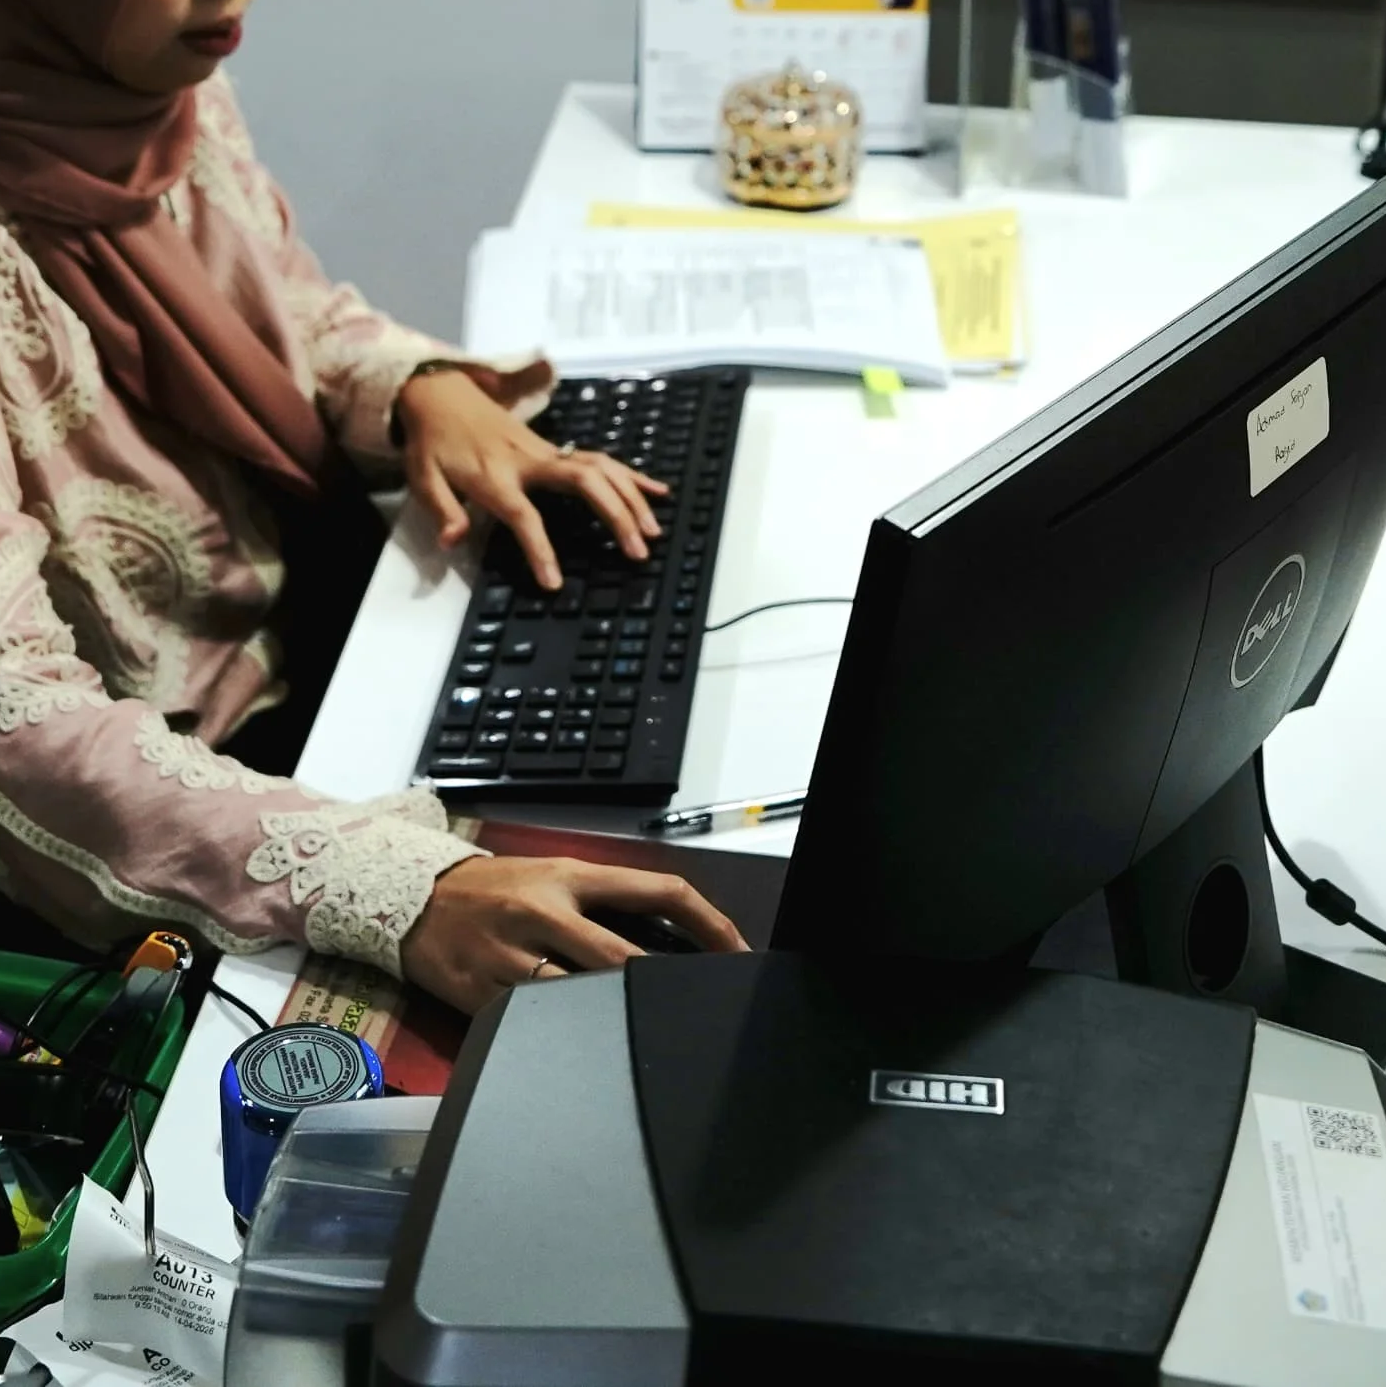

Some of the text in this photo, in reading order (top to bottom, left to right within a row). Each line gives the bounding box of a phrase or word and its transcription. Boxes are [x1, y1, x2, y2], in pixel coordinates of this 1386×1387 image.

[1240, 592, 1293, 655] DELL
[339, 996, 370, 1032] Pasa
[886, 1080, 990, 1105] HID
[153, 1270, 216, 1300] COUNTER
[188, 1301, 213, 1315] Orang
[195, 1314, 216, 1326] anda
